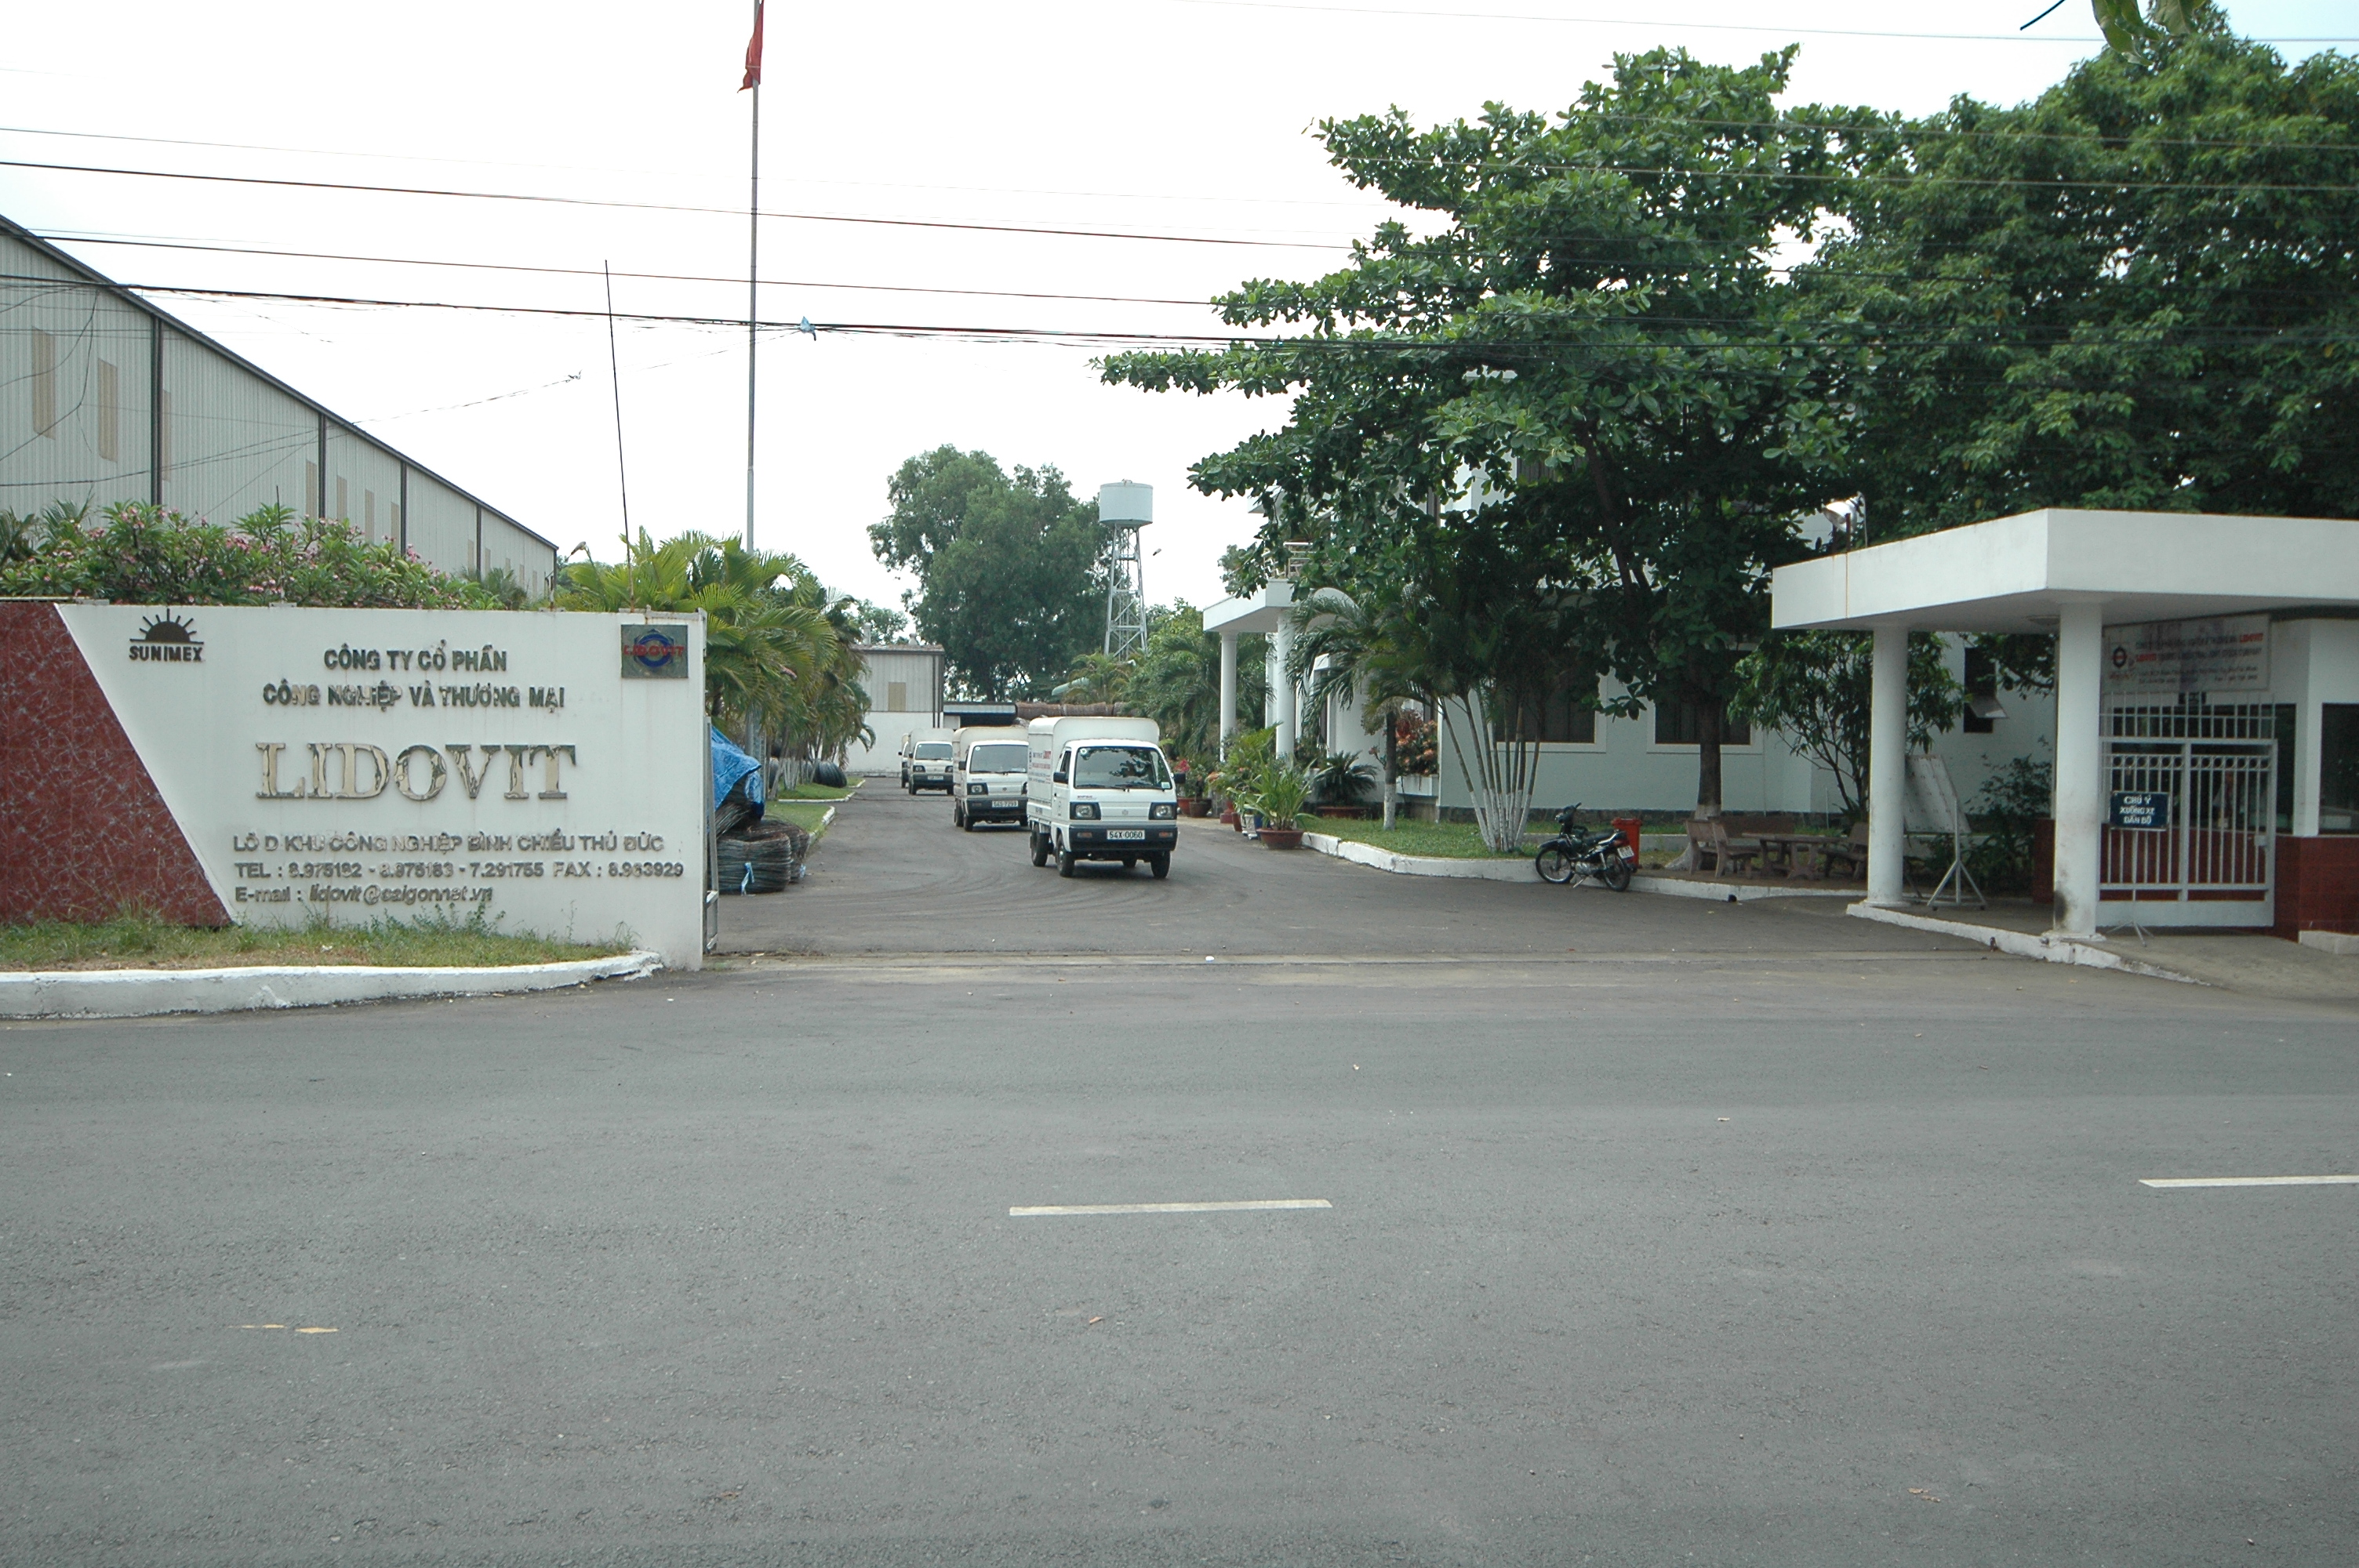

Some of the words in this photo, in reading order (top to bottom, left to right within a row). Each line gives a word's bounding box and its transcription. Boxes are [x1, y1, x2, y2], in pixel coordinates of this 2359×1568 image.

[129, 645, 205, 662] SUNIMEX
[324, 643, 380, 670] CÔNG
[387, 650, 414, 671] TY
[263, 678, 321, 706] CÔNG
[409, 680, 435, 707] VÀ
[529, 686, 565, 713] MẠI
[255, 742, 577, 801] LIDOVIT
[264, 836, 279, 852] D
[285, 835, 325, 852] KHU
[329, 830, 387, 852] CÔNG
[234, 862, 271, 878] TEL
[553, 861, 591, 877] FAX
[235, 885, 292, 902] E-mail
